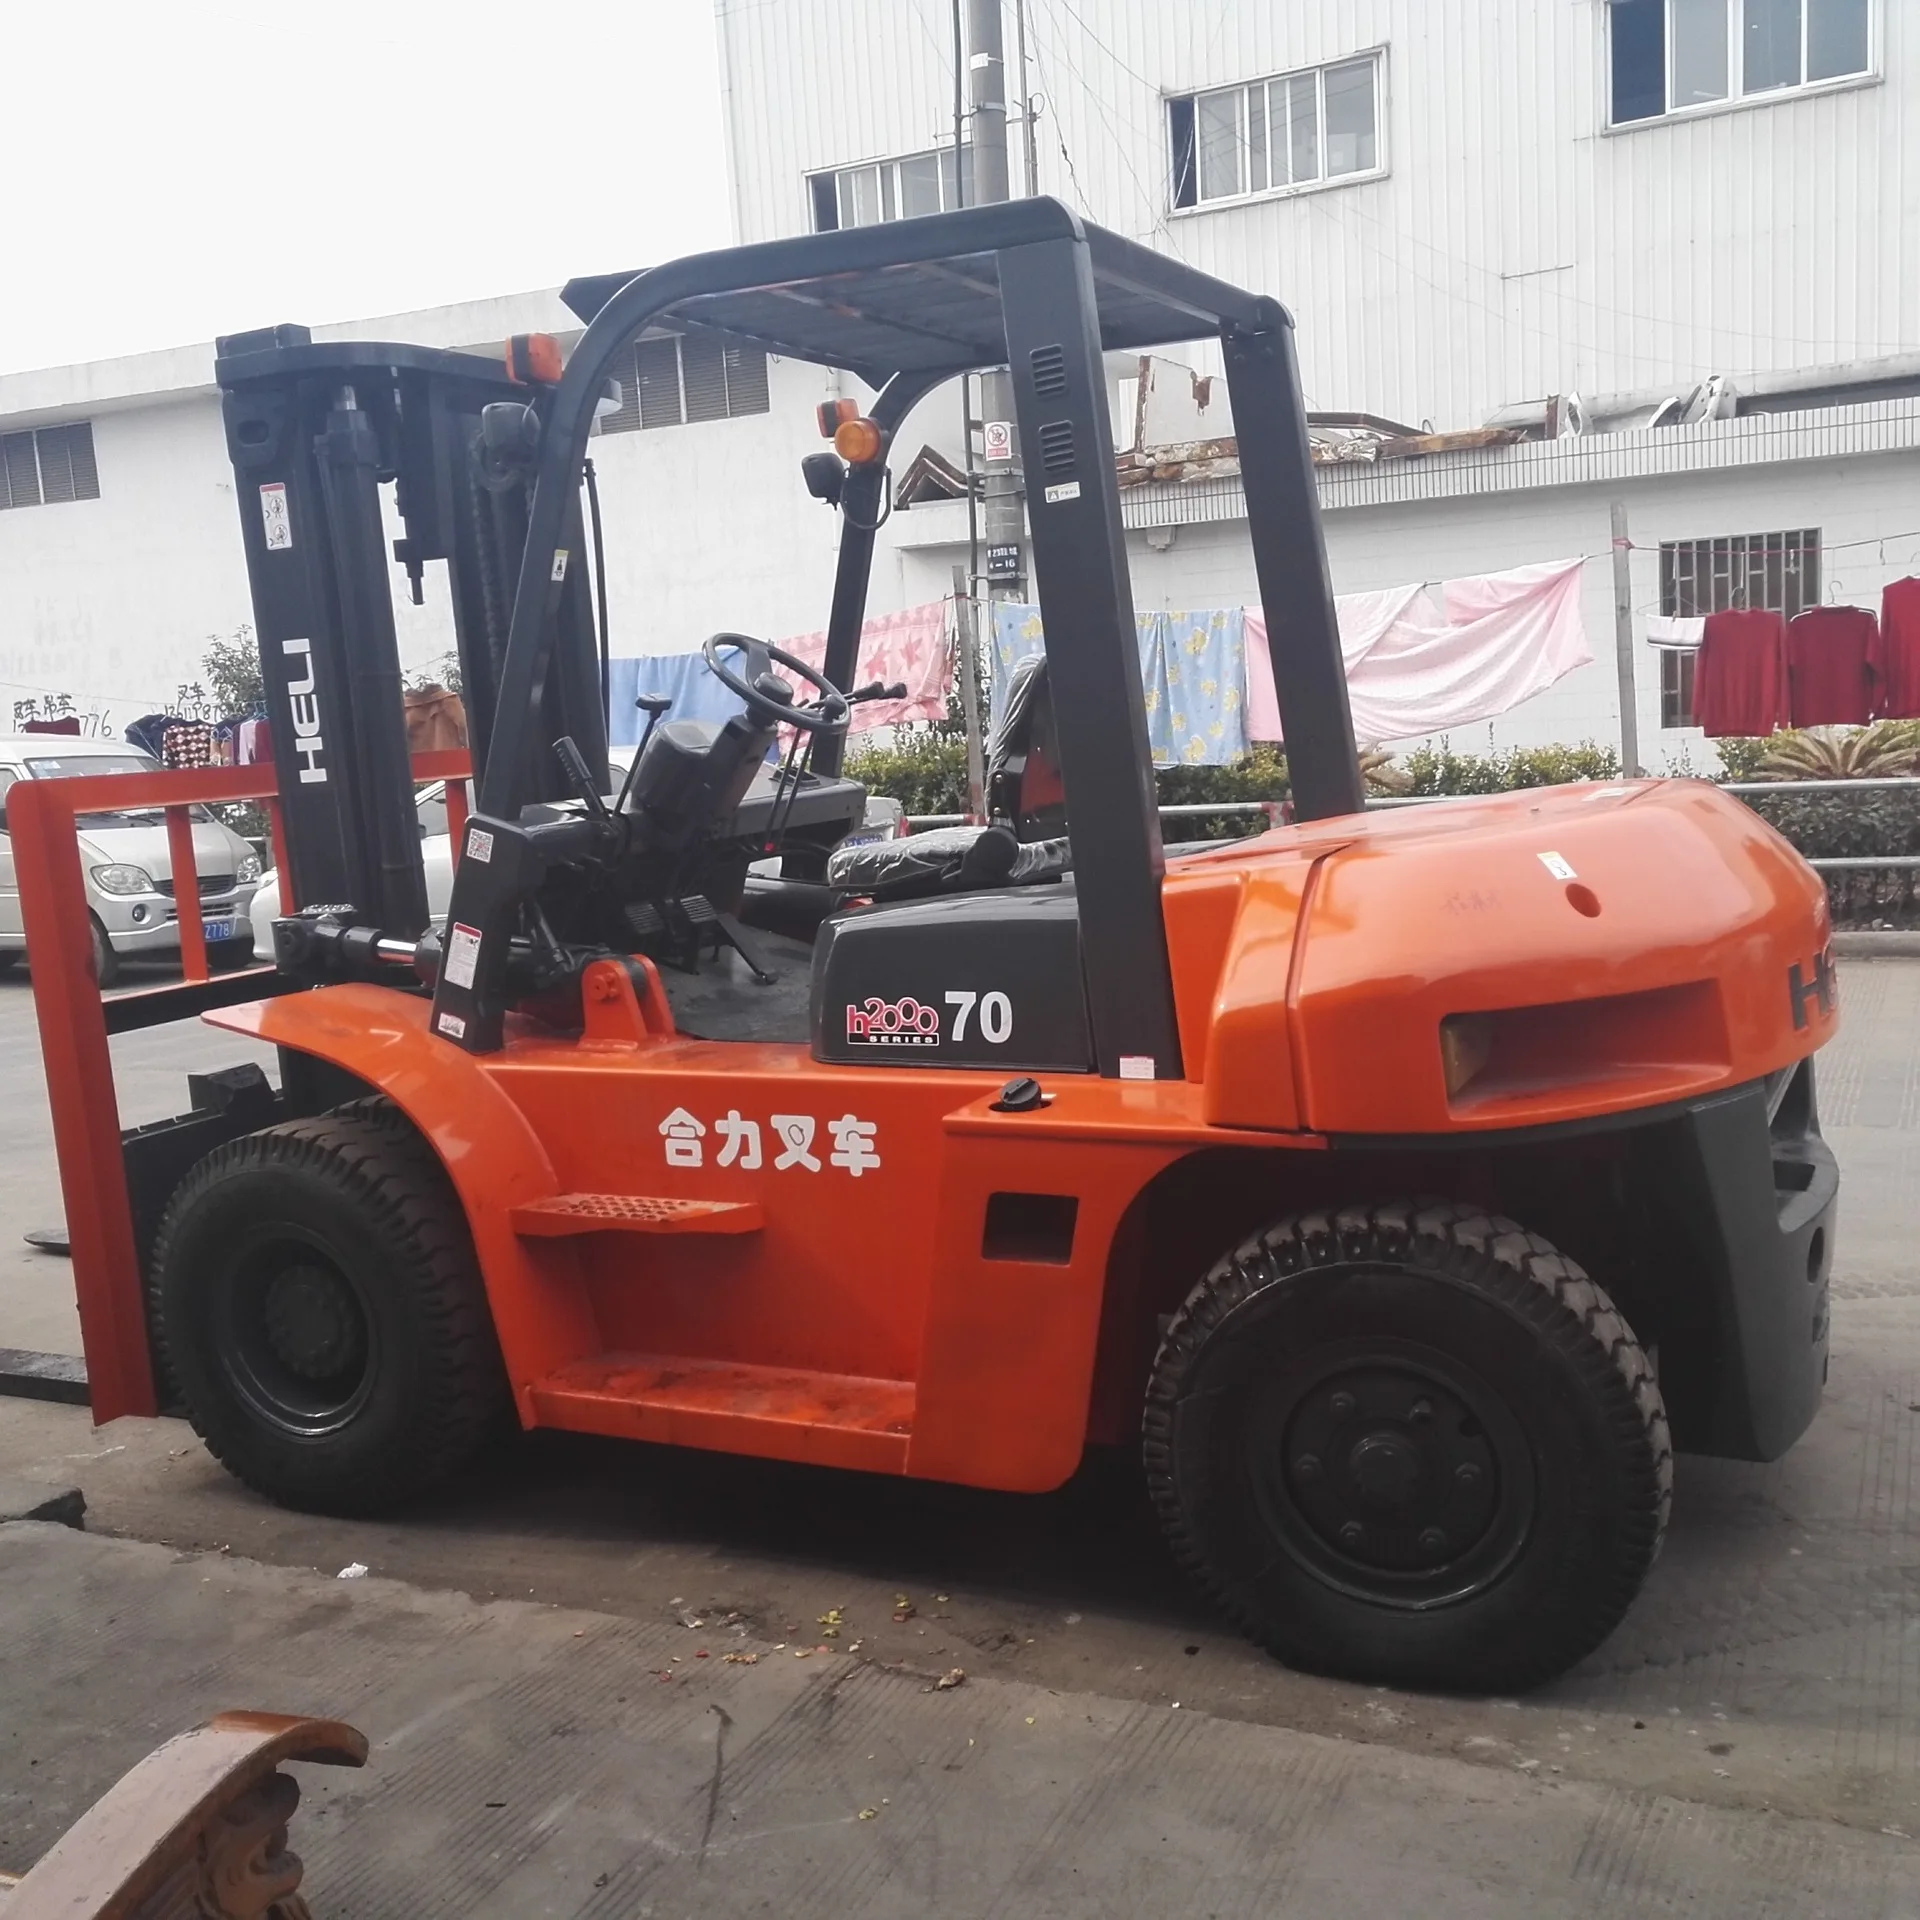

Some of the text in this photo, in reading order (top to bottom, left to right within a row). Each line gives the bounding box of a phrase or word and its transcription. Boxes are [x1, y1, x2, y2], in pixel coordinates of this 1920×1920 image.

[282, 638, 328, 784] HELI
[869, 1035, 933, 1044] SERIES
[945, 991, 1012, 1043] 70
[658, 1107, 881, 1177] 合力叉车
